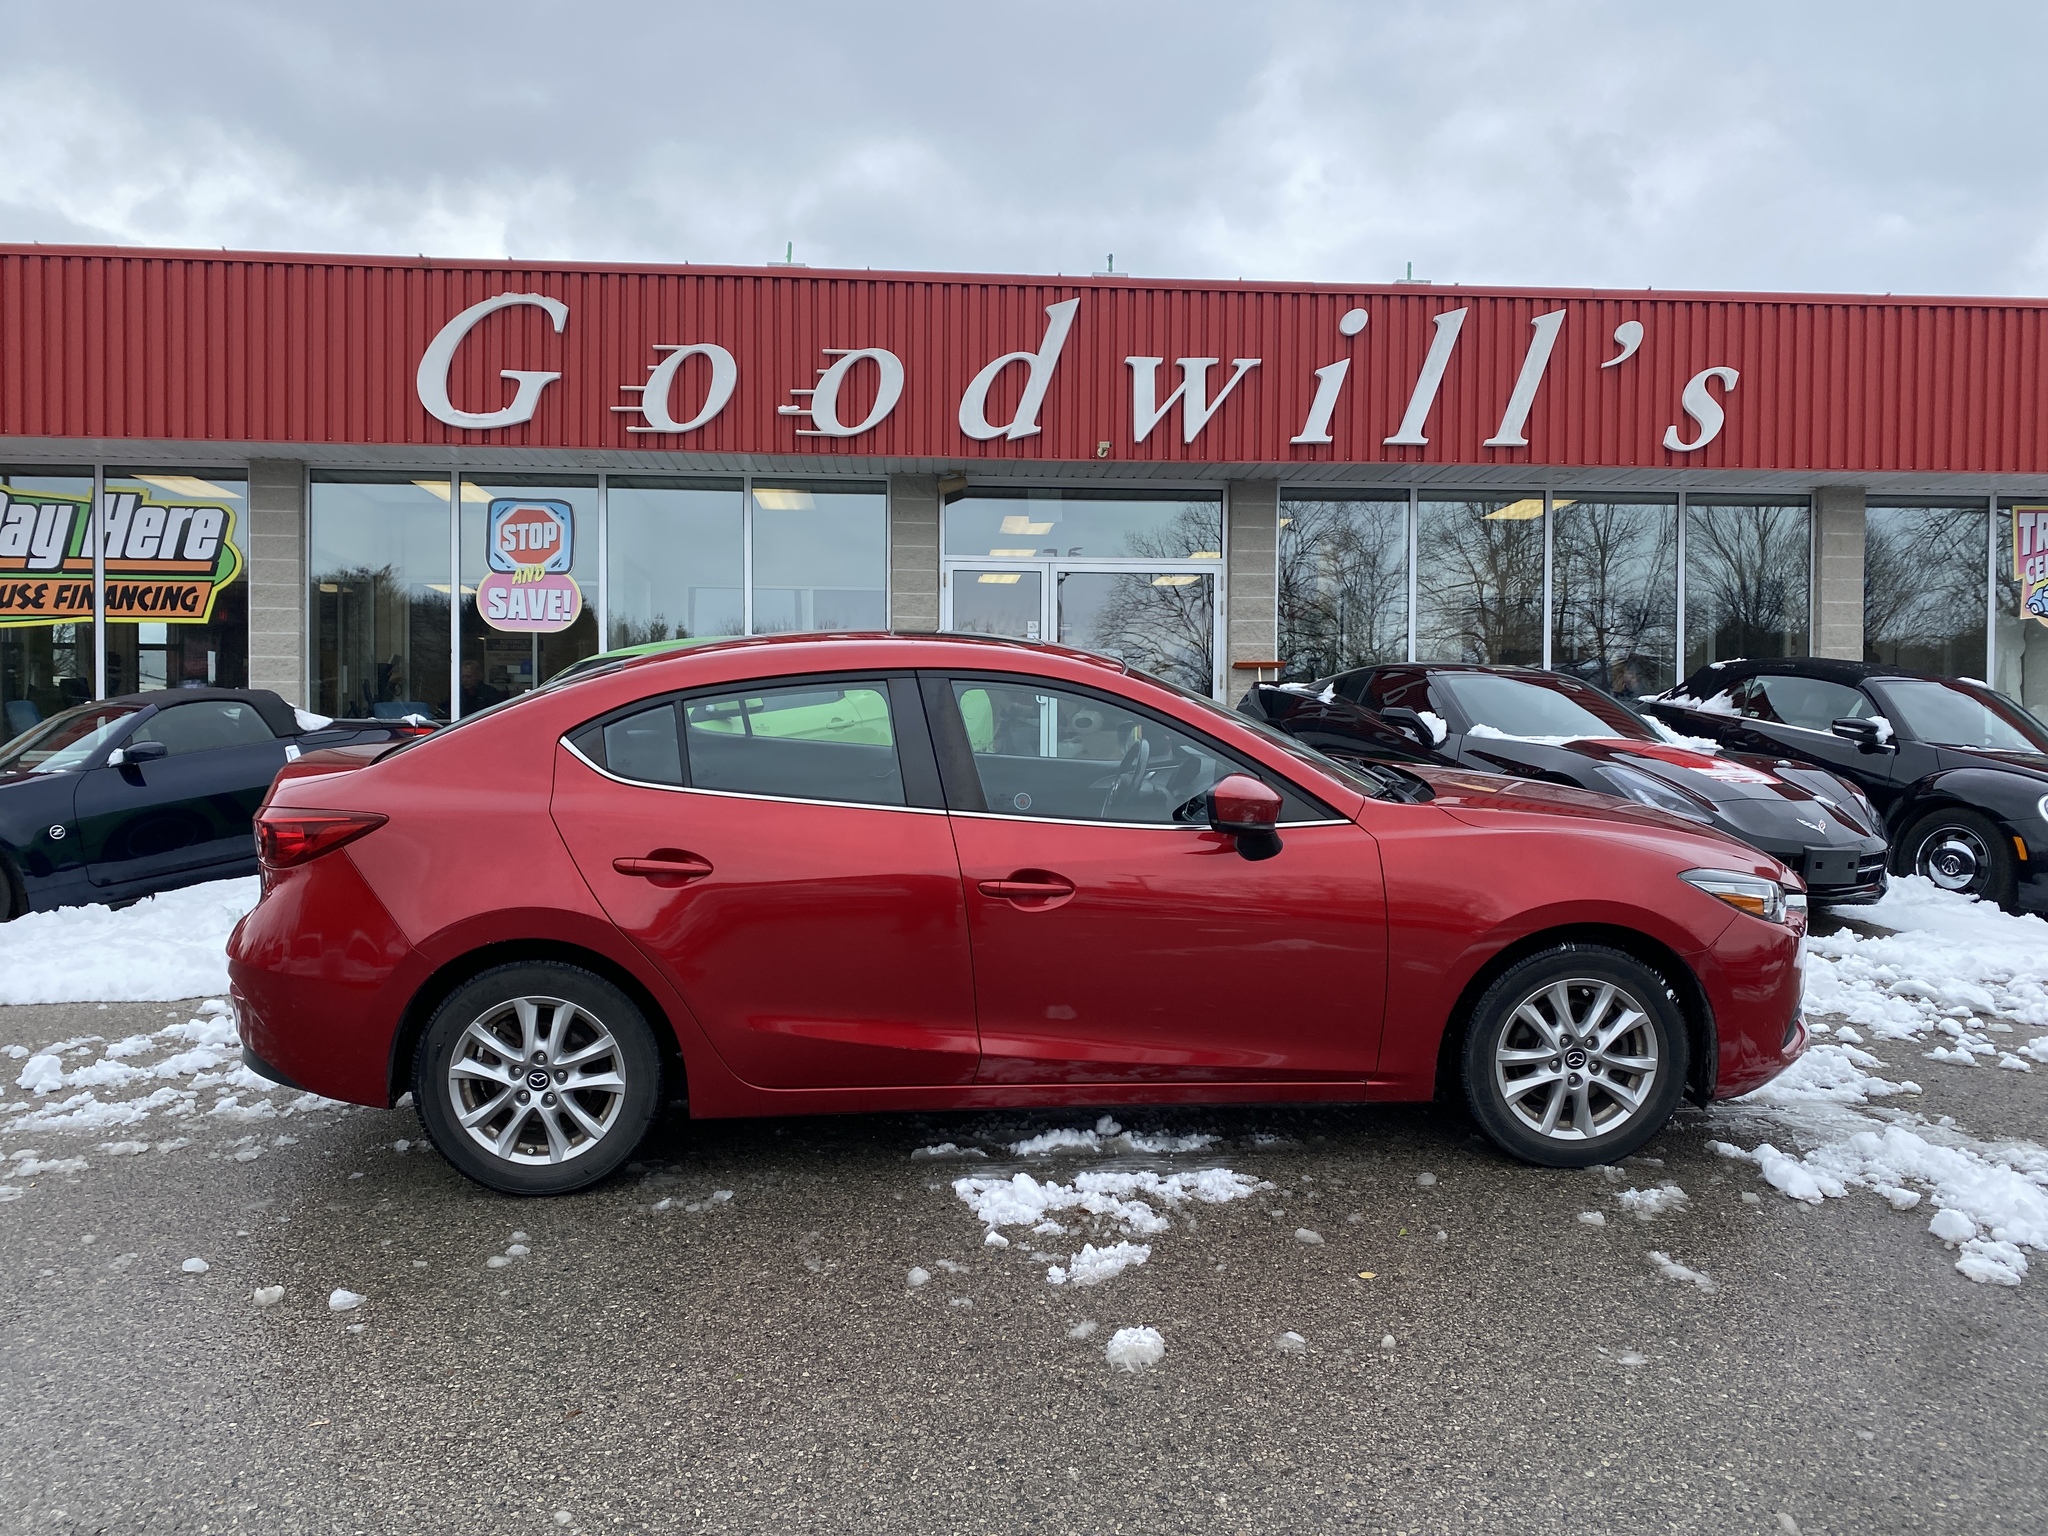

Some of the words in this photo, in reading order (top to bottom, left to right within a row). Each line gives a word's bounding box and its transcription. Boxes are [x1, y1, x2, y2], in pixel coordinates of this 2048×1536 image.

[416, 292, 1740, 454] Goodwill's
[81, 493, 225, 560] Here
[502, 521, 558, 552] STOP
[511, 564, 546, 585] AND
[2025, 554, 2048, 586] CE
[53, 584, 200, 613] FINANCING
[487, 586, 573, 622] SAVE!
